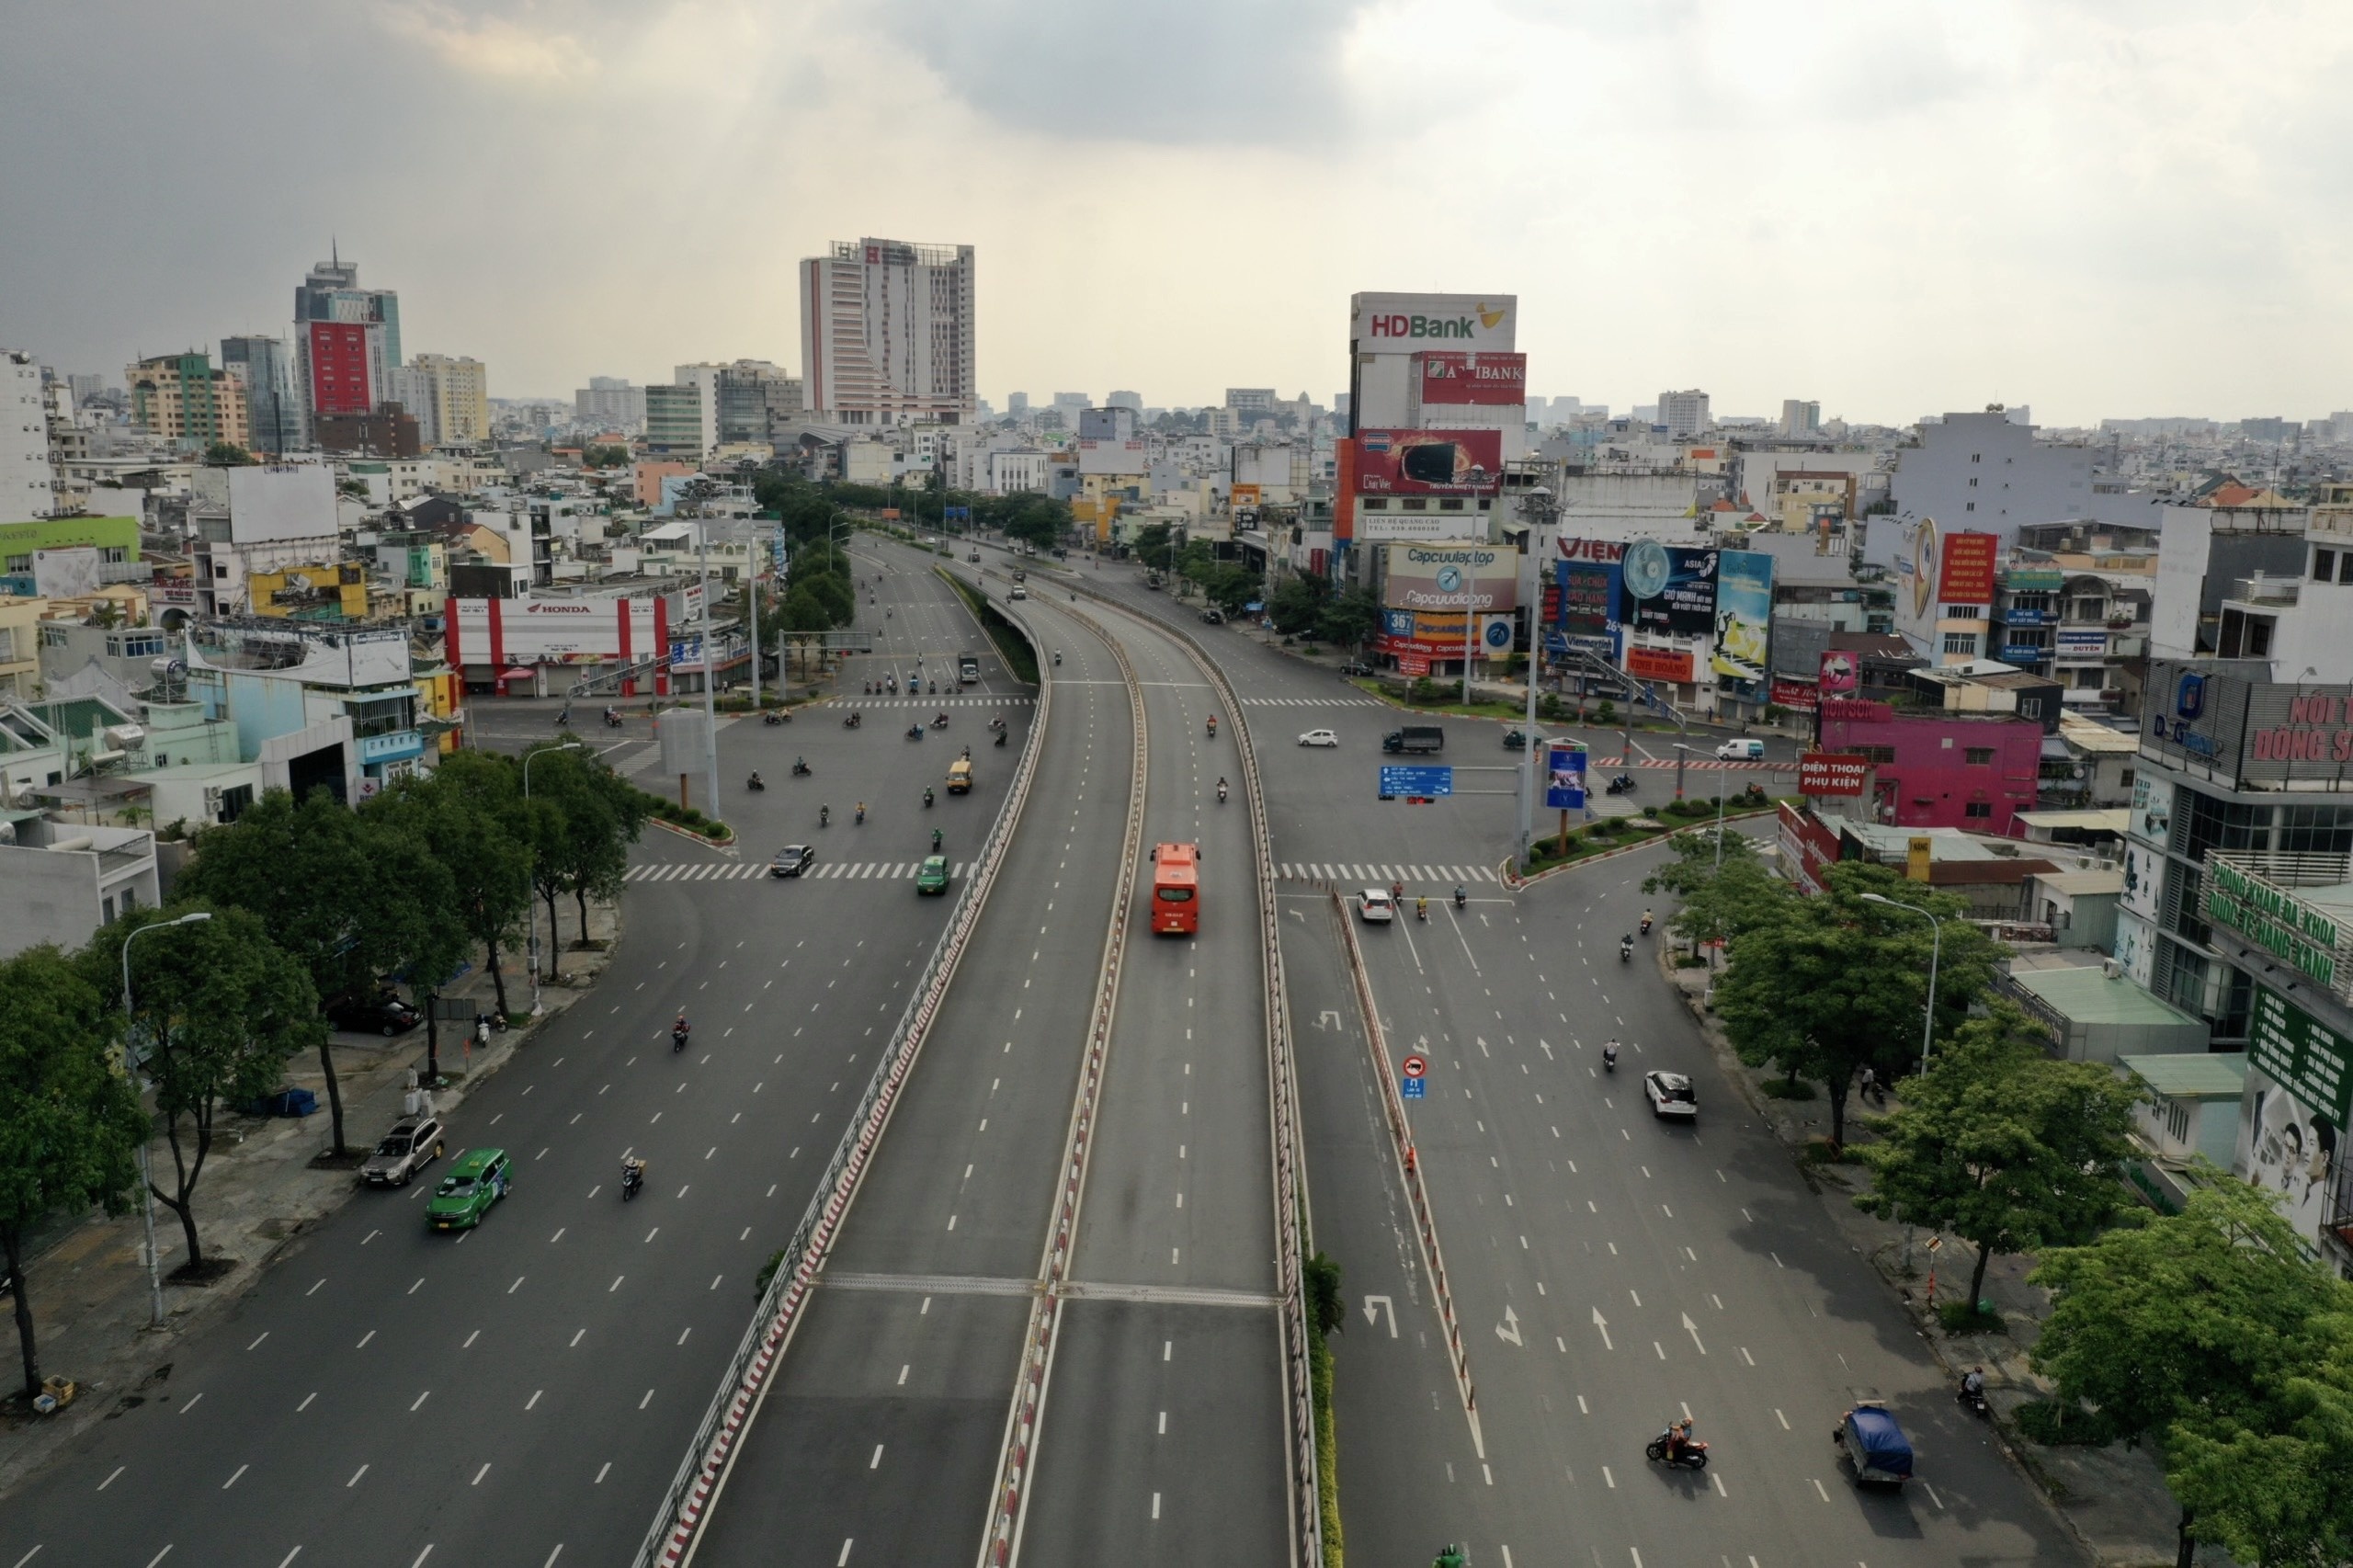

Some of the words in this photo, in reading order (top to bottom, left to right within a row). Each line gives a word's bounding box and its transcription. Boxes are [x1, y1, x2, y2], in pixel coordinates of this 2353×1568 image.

[1371, 314, 1474, 338] HDBank
[1557, 537, 1622, 562] VIỆN
[1684, 559, 1702, 569] ASIA
[1676, 591, 1697, 603] MẠNH
[1802, 761, 1827, 775] ĐIỆN
[1831, 764, 1865, 776] THOẠI
[1804, 777, 1828, 789] PHỤ
[1832, 777, 1859, 790] KIỆN
[2302, 909, 2338, 949] KHOA
